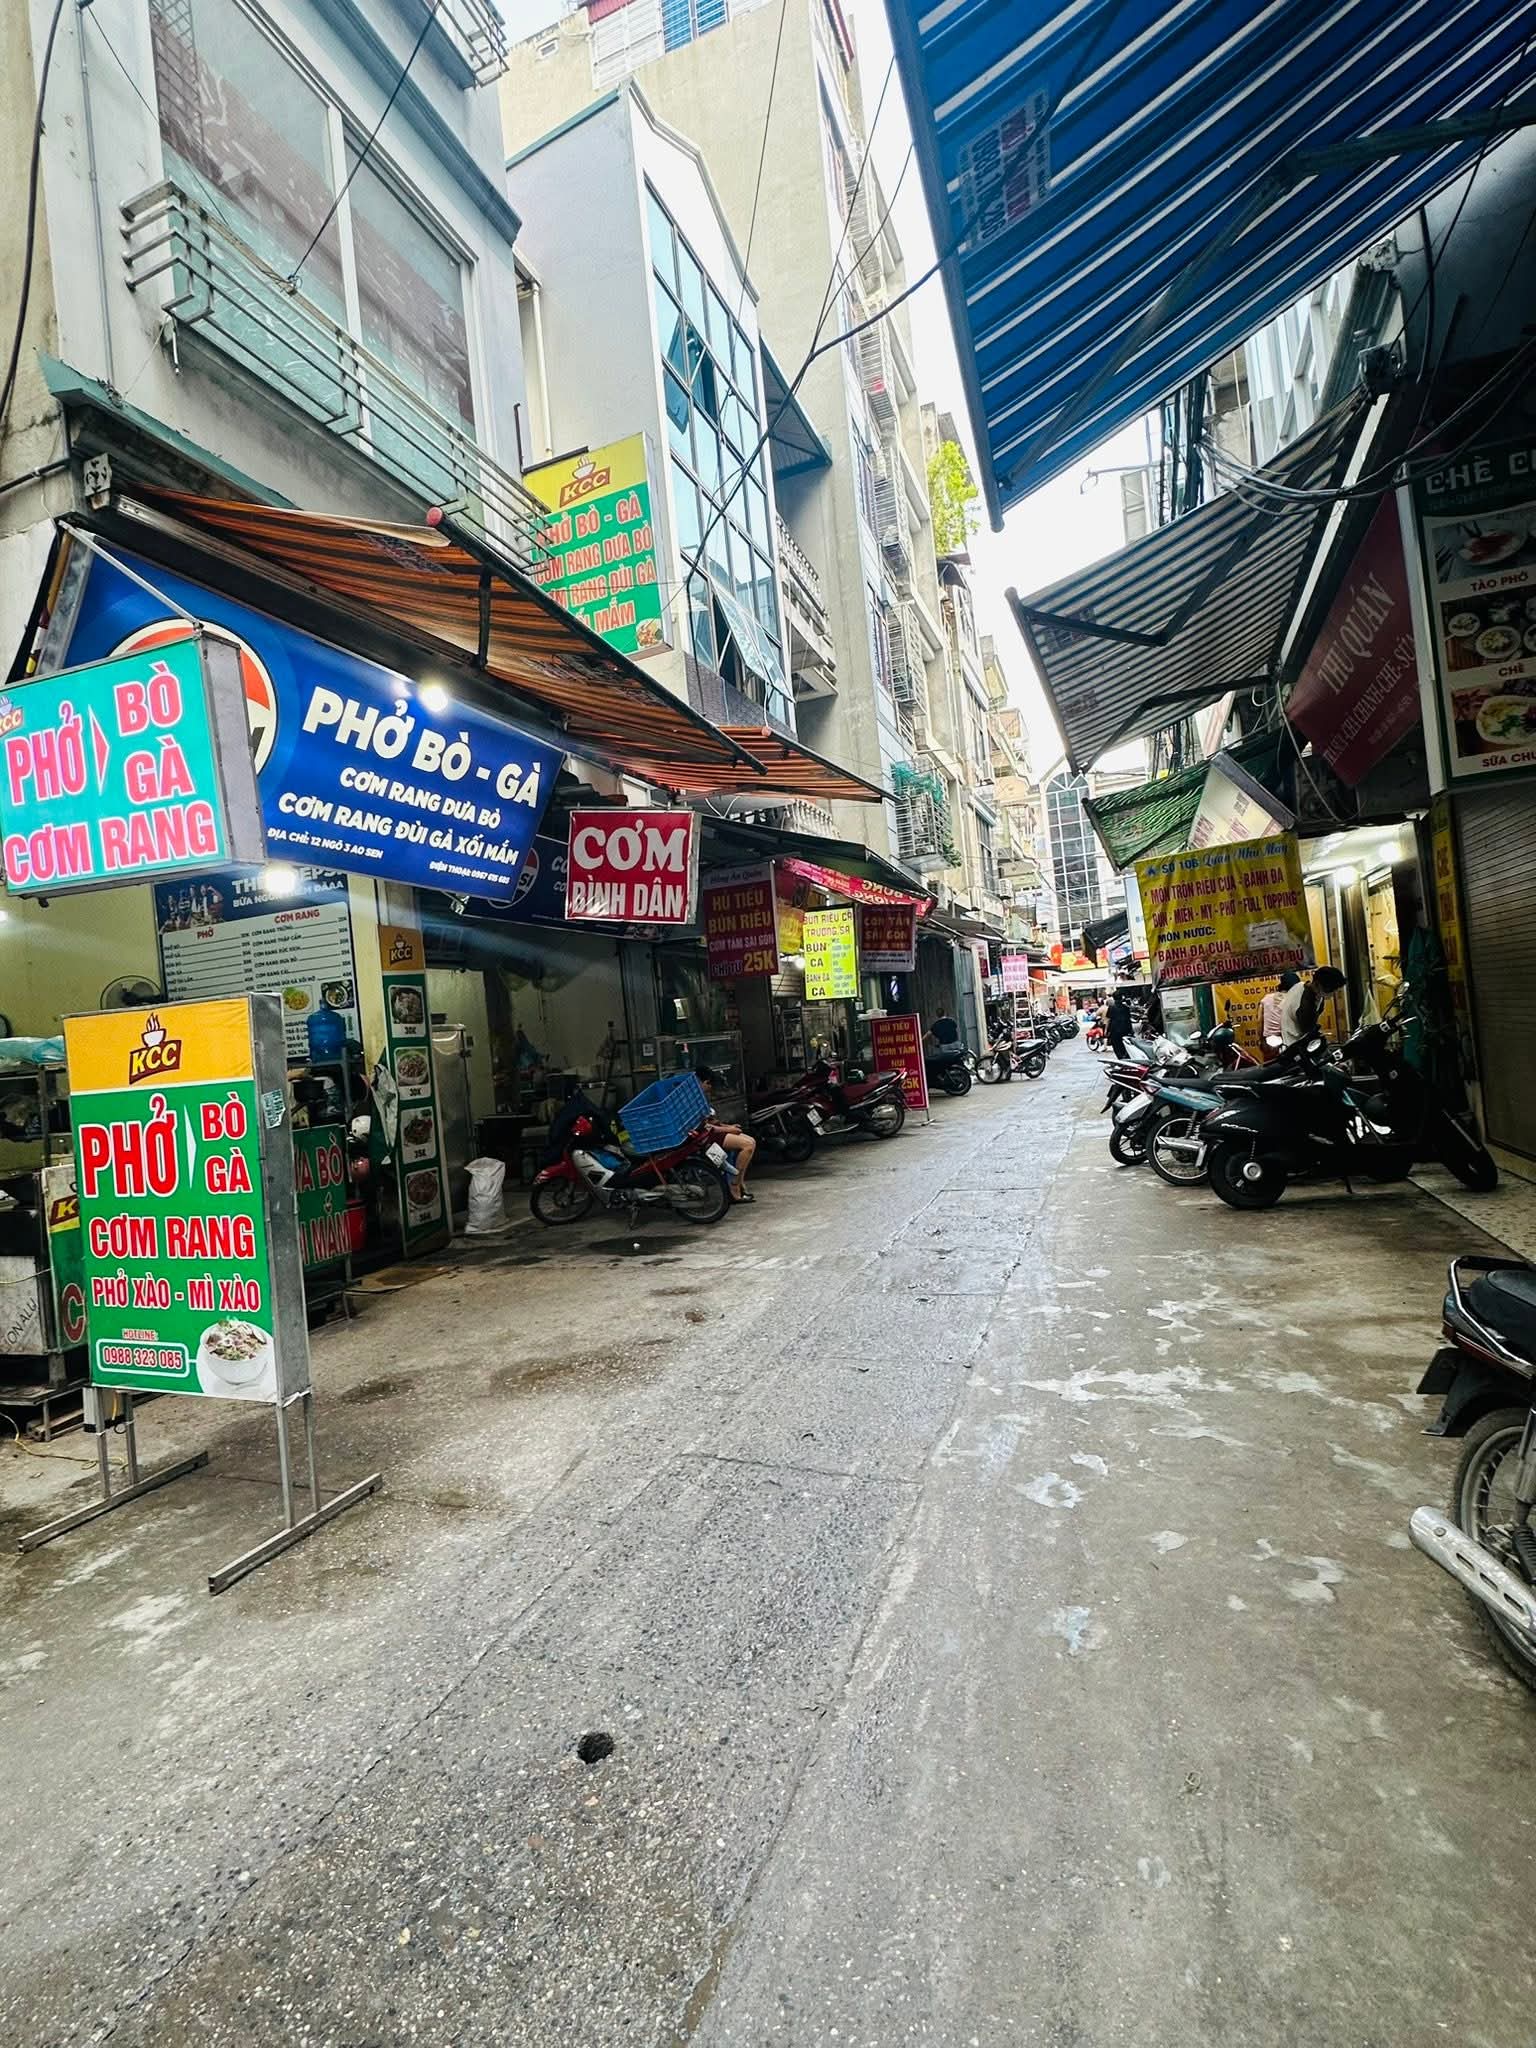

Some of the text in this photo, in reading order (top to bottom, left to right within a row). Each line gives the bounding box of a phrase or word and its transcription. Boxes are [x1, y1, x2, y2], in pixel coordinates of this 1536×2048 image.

[563, 470, 608, 502] KCC
[576, 503, 600, 541] BÒ
[616, 490, 642, 524] GÀ
[566, 543, 600, 578] RANG
[633, 520, 652, 552] BÒ
[569, 574, 605, 607] RANG
[114, 660, 183, 737] BÒ
[5, 700, 87, 806] PHỞ
[124, 734, 196, 805] GÀ
[302, 686, 416, 759] PHỞ
[411, 729, 472, 781] BÒ
[496, 762, 543, 808] GÀ
[340, 767, 501, 829] CƠM RANG DƯA BÒ
[4, 800, 218, 886] CƠM RANG
[267, 827, 287, 841] ĐỊA
[310, 836, 321, 847] 12
[343, 843, 351, 852] 3
[365, 847, 384, 859] SEN
[278, 792, 519, 866] CƠM RANG ĐÙI GÀ XỐI MẮM
[573, 819, 687, 872] CƠM
[274, 909, 320, 924] CƠM RANG
[572, 874, 682, 918] BÌNH DÂN
[196, 926, 214, 940] PHỞ
[743, 948, 776, 973] 25K
[131, 1043, 179, 1077] KCC
[201, 1092, 247, 1142] BÒ
[79, 1093, 178, 1198] PHỞ
[205, 1148, 253, 1195] GÀ
[90, 1214, 256, 1260] CƠM RANG
[93, 1269, 129, 1308] PHỞ
[133, 1273, 171, 1311] XÀO
[188, 1272, 214, 1312] MÌ
[219, 1275, 261, 1314] XÀO
[103, 1348, 183, 1369] 0988 323 085
